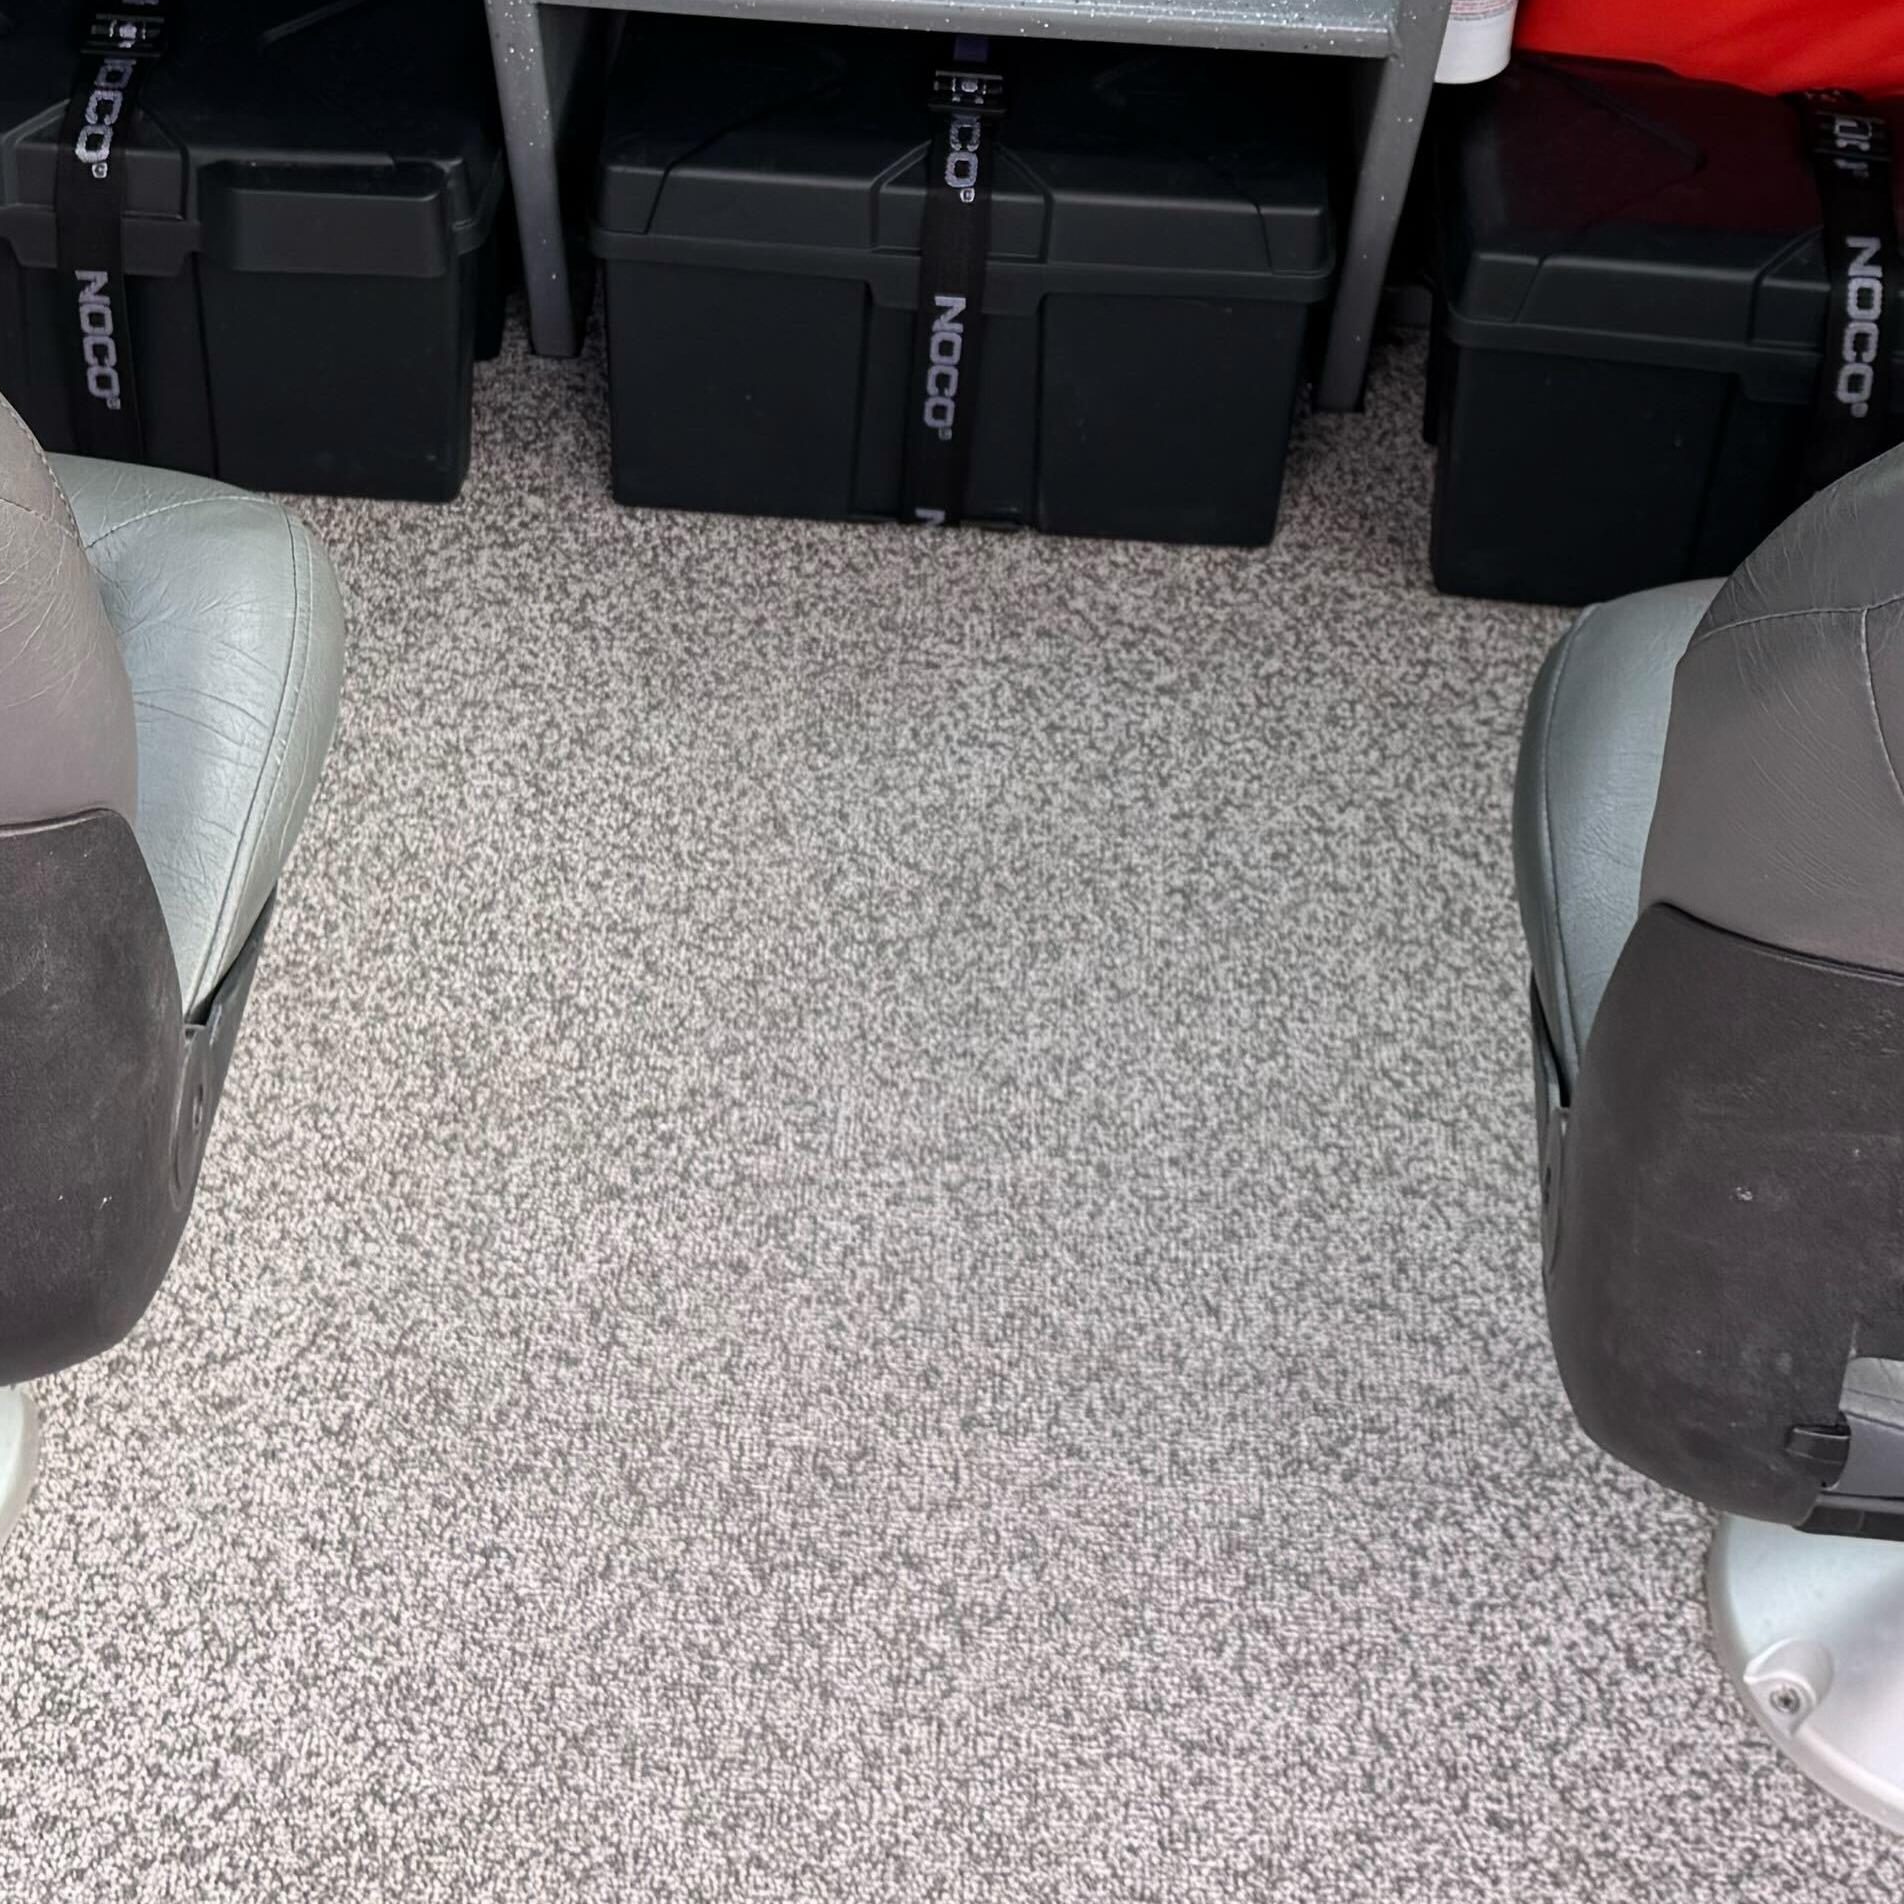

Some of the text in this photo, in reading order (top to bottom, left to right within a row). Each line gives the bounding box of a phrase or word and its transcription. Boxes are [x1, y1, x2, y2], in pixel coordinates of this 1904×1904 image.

[75, 59, 136, 164] OCO
[74, 269, 121, 399] NOCO
[924, 295, 967, 429] NOCO
[1836, 236, 1883, 404] NOCO
